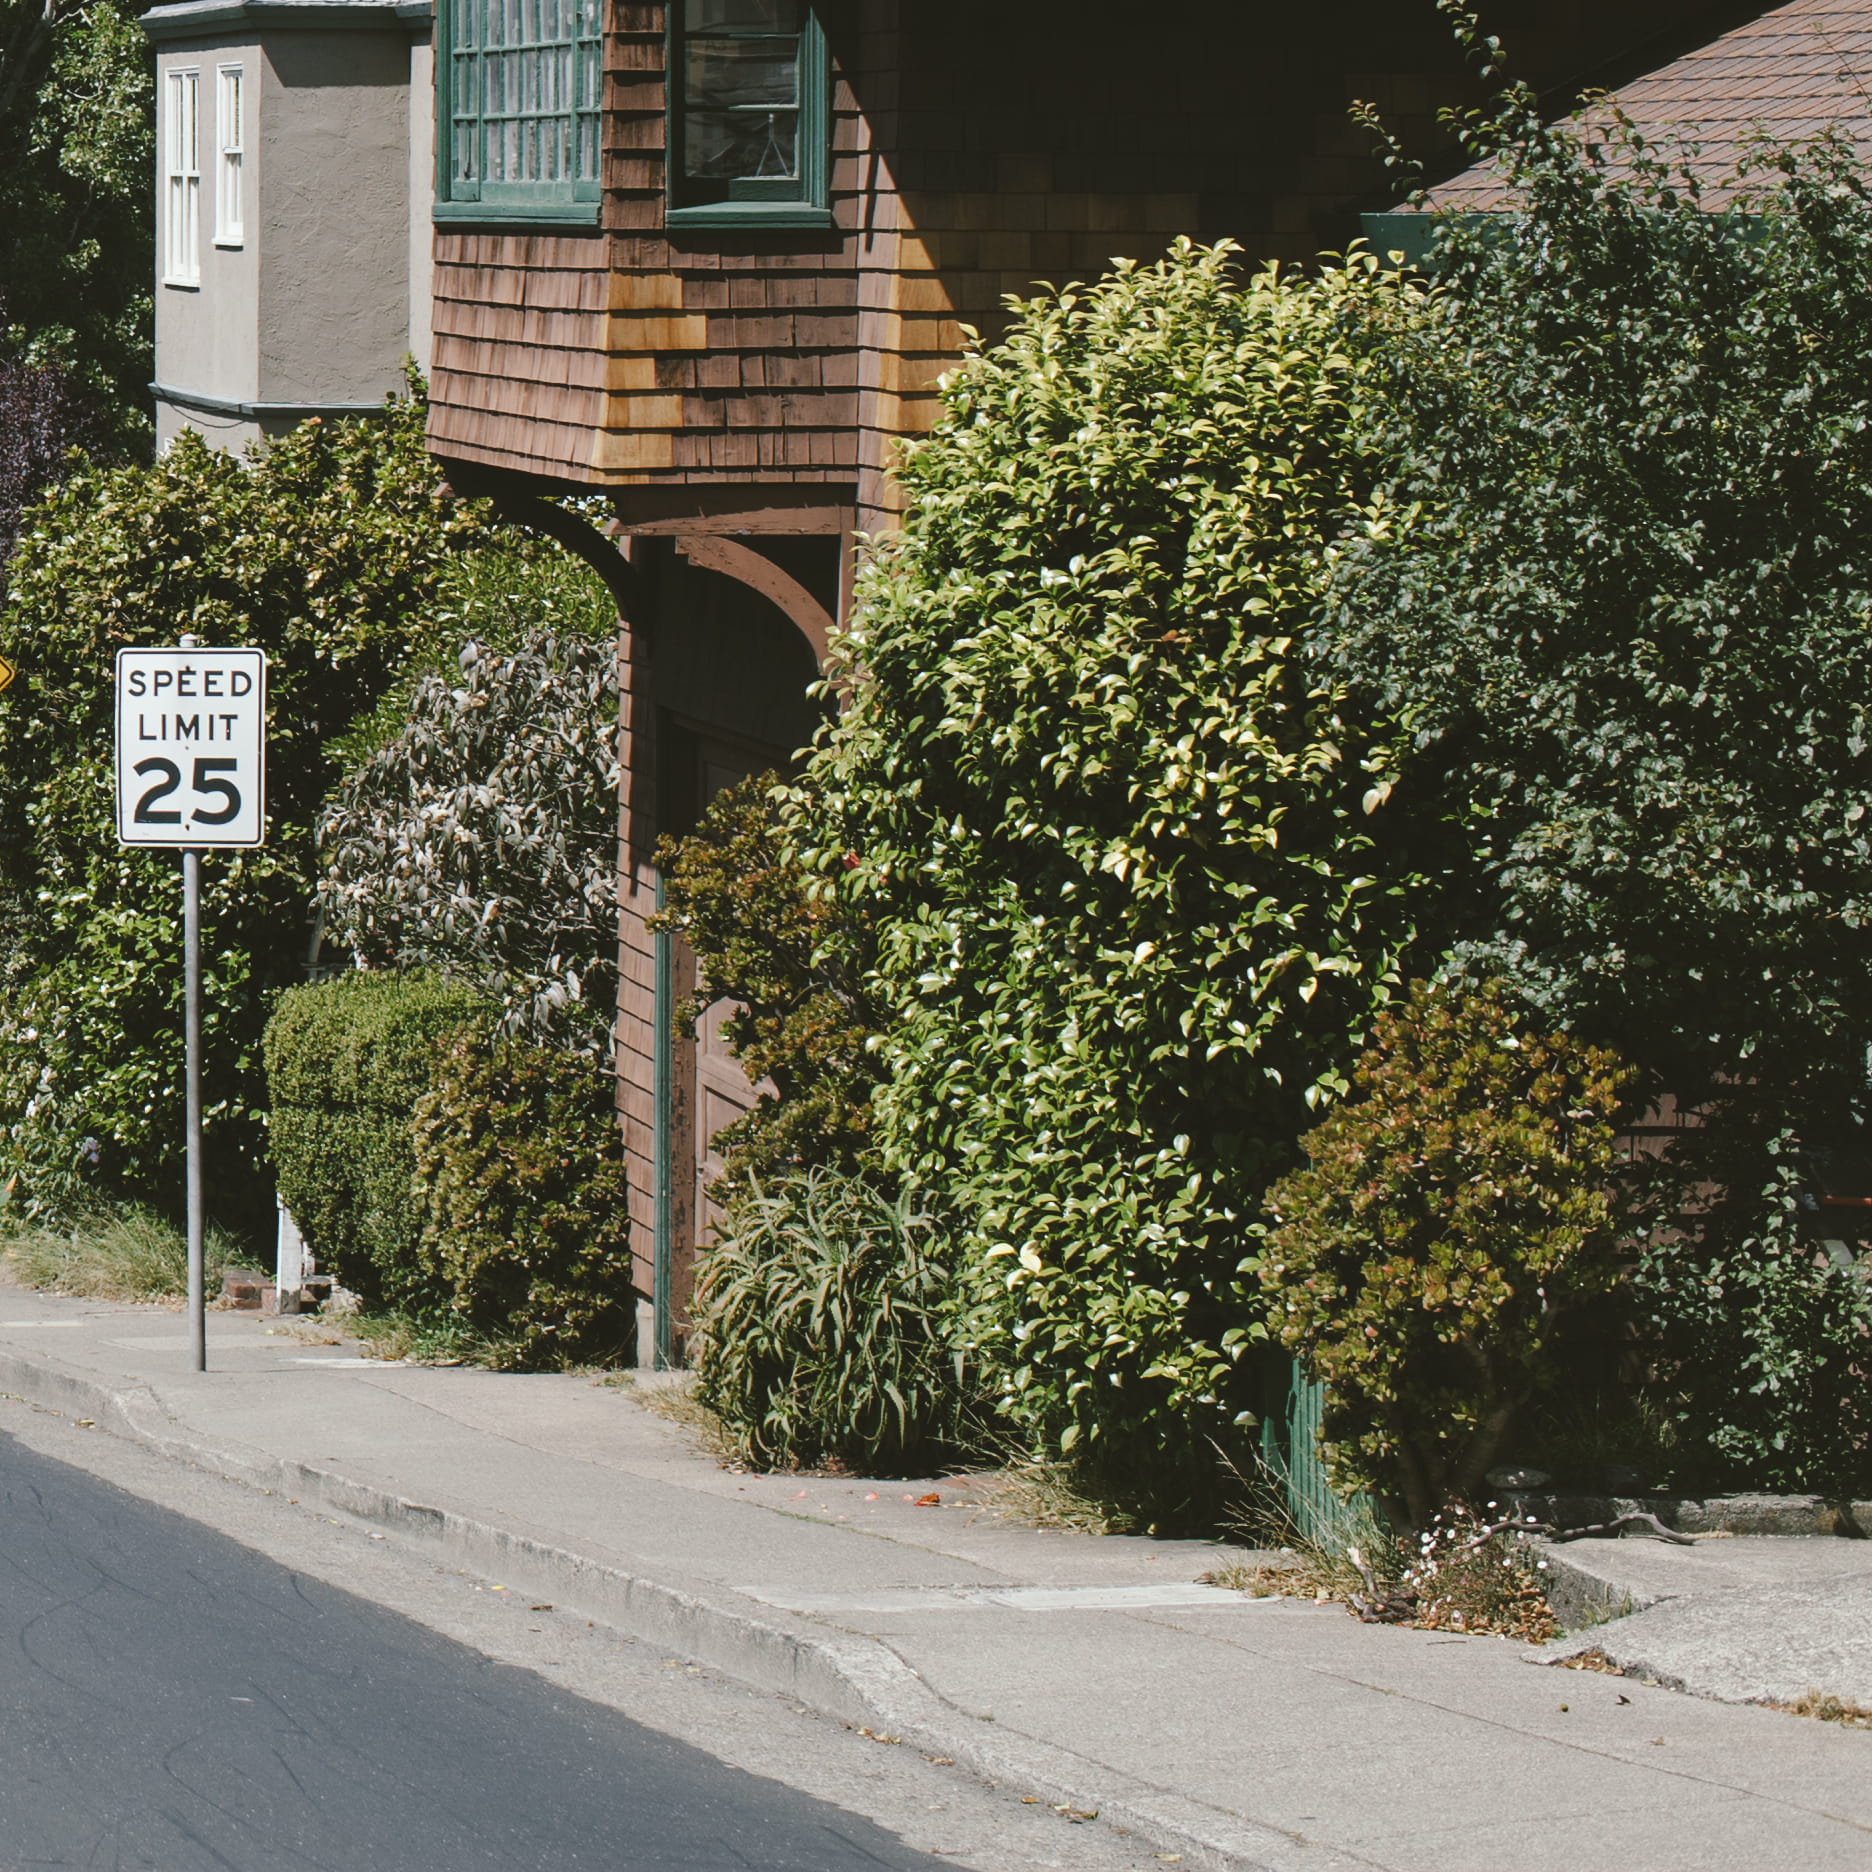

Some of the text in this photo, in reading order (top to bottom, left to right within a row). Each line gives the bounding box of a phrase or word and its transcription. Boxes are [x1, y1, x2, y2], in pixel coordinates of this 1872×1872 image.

[128, 670, 252, 697] SPEED
[139, 714, 238, 741] LIMIT
[133, 757, 242, 826] 25
